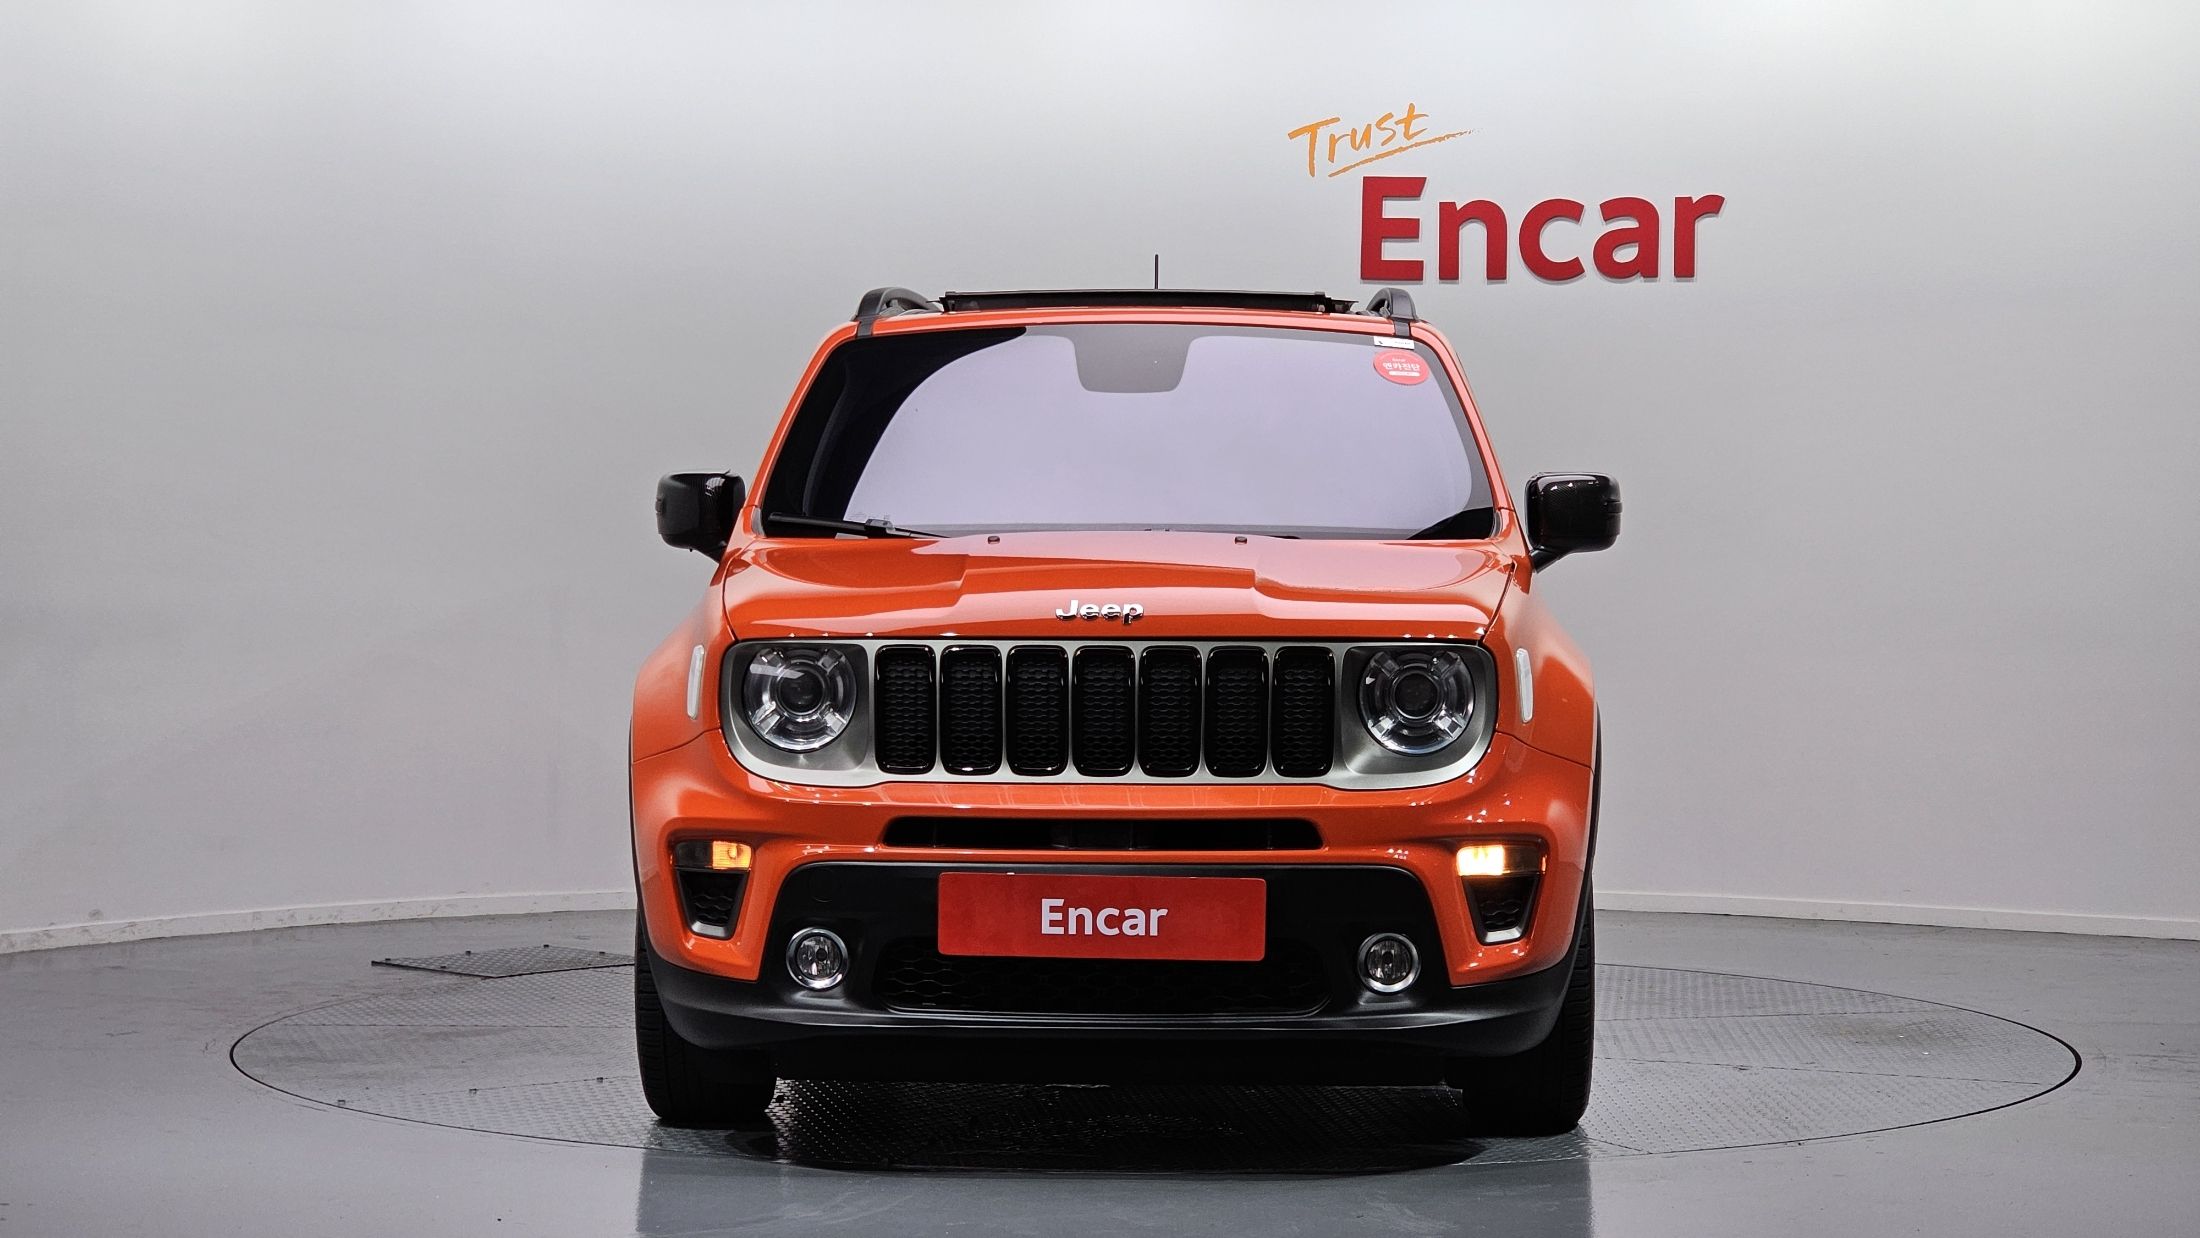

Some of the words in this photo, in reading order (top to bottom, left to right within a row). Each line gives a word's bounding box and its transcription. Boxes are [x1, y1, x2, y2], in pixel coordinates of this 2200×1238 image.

[1288, 102, 1430, 177] Trust
[1360, 175, 1726, 283] Encar
[1055, 599, 1144, 625] Jeep
[1041, 898, 1168, 936] Encar
